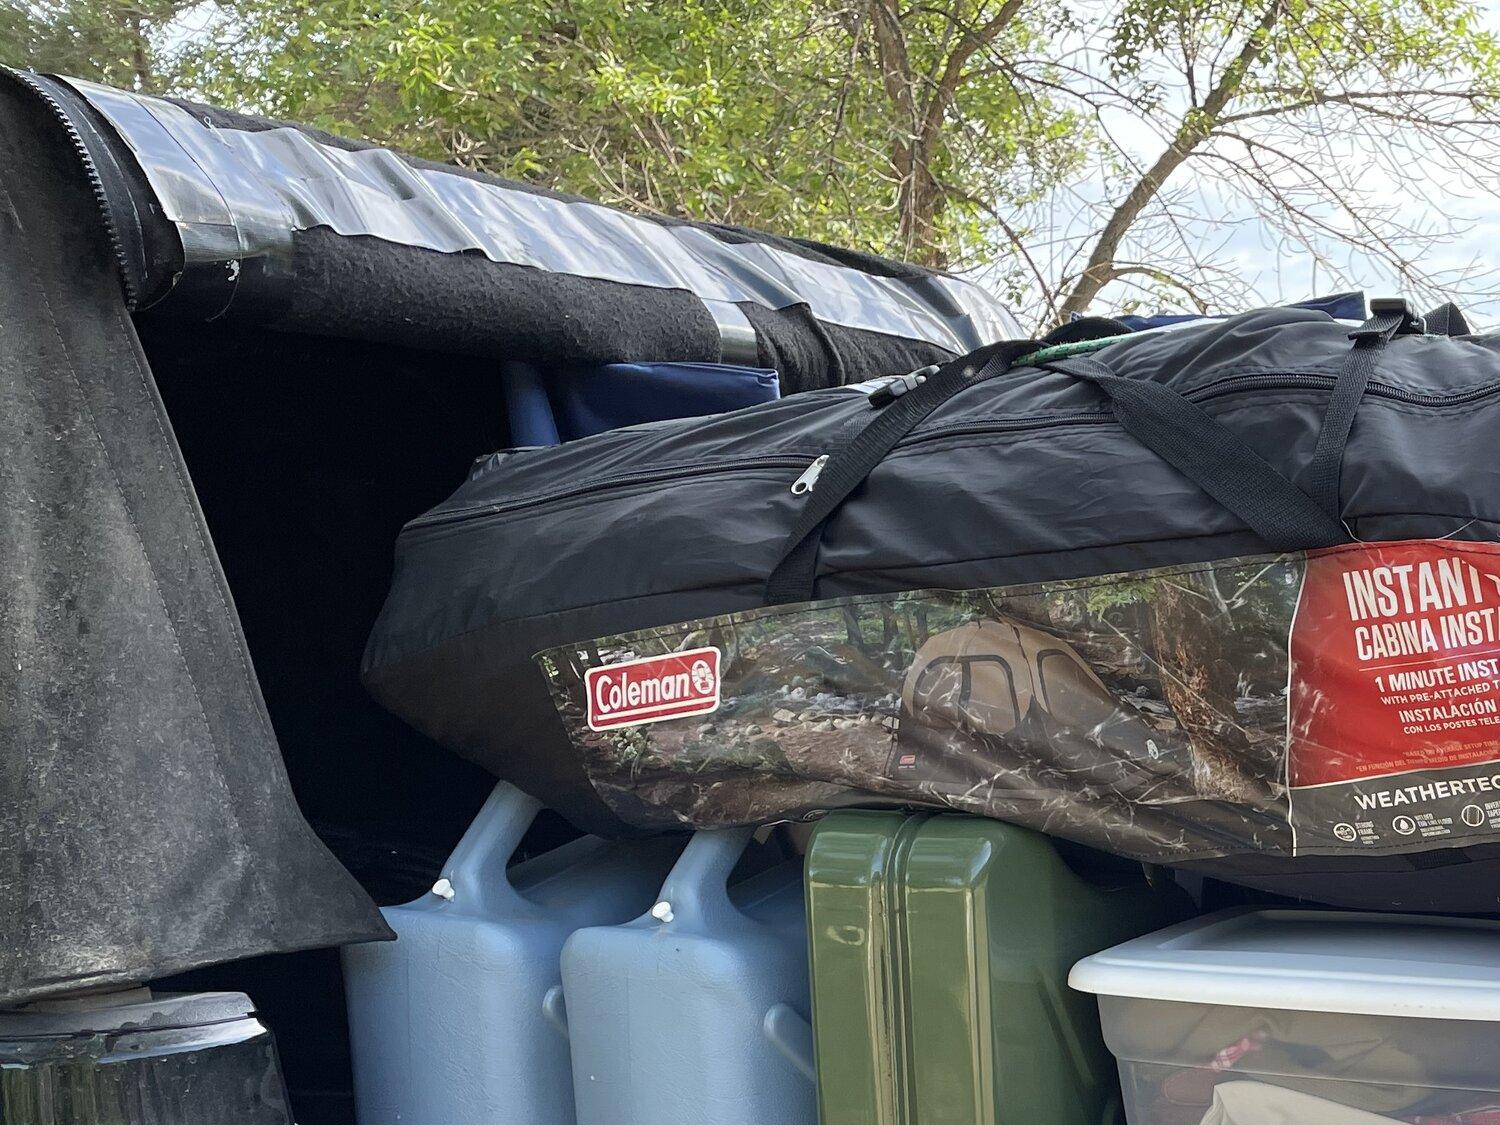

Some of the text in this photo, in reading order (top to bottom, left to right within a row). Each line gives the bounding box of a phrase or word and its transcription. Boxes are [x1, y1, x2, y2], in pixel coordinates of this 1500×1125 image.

[1354, 618, 1439, 661] CABINA
[1375, 676, 1385, 692] 1
[1389, 667, 1456, 692] MINUTE
[596, 672, 689, 714] Coleman
[1381, 695, 1408, 705] WITH
[1410, 681, 1490, 703] PRE-ATTACHED
[1398, 698, 1497, 723] INSTALACIÓN
[1403, 725, 1423, 735] CON
[1424, 722, 1442, 732] LOS
[1444, 719, 1478, 730] POSTES
